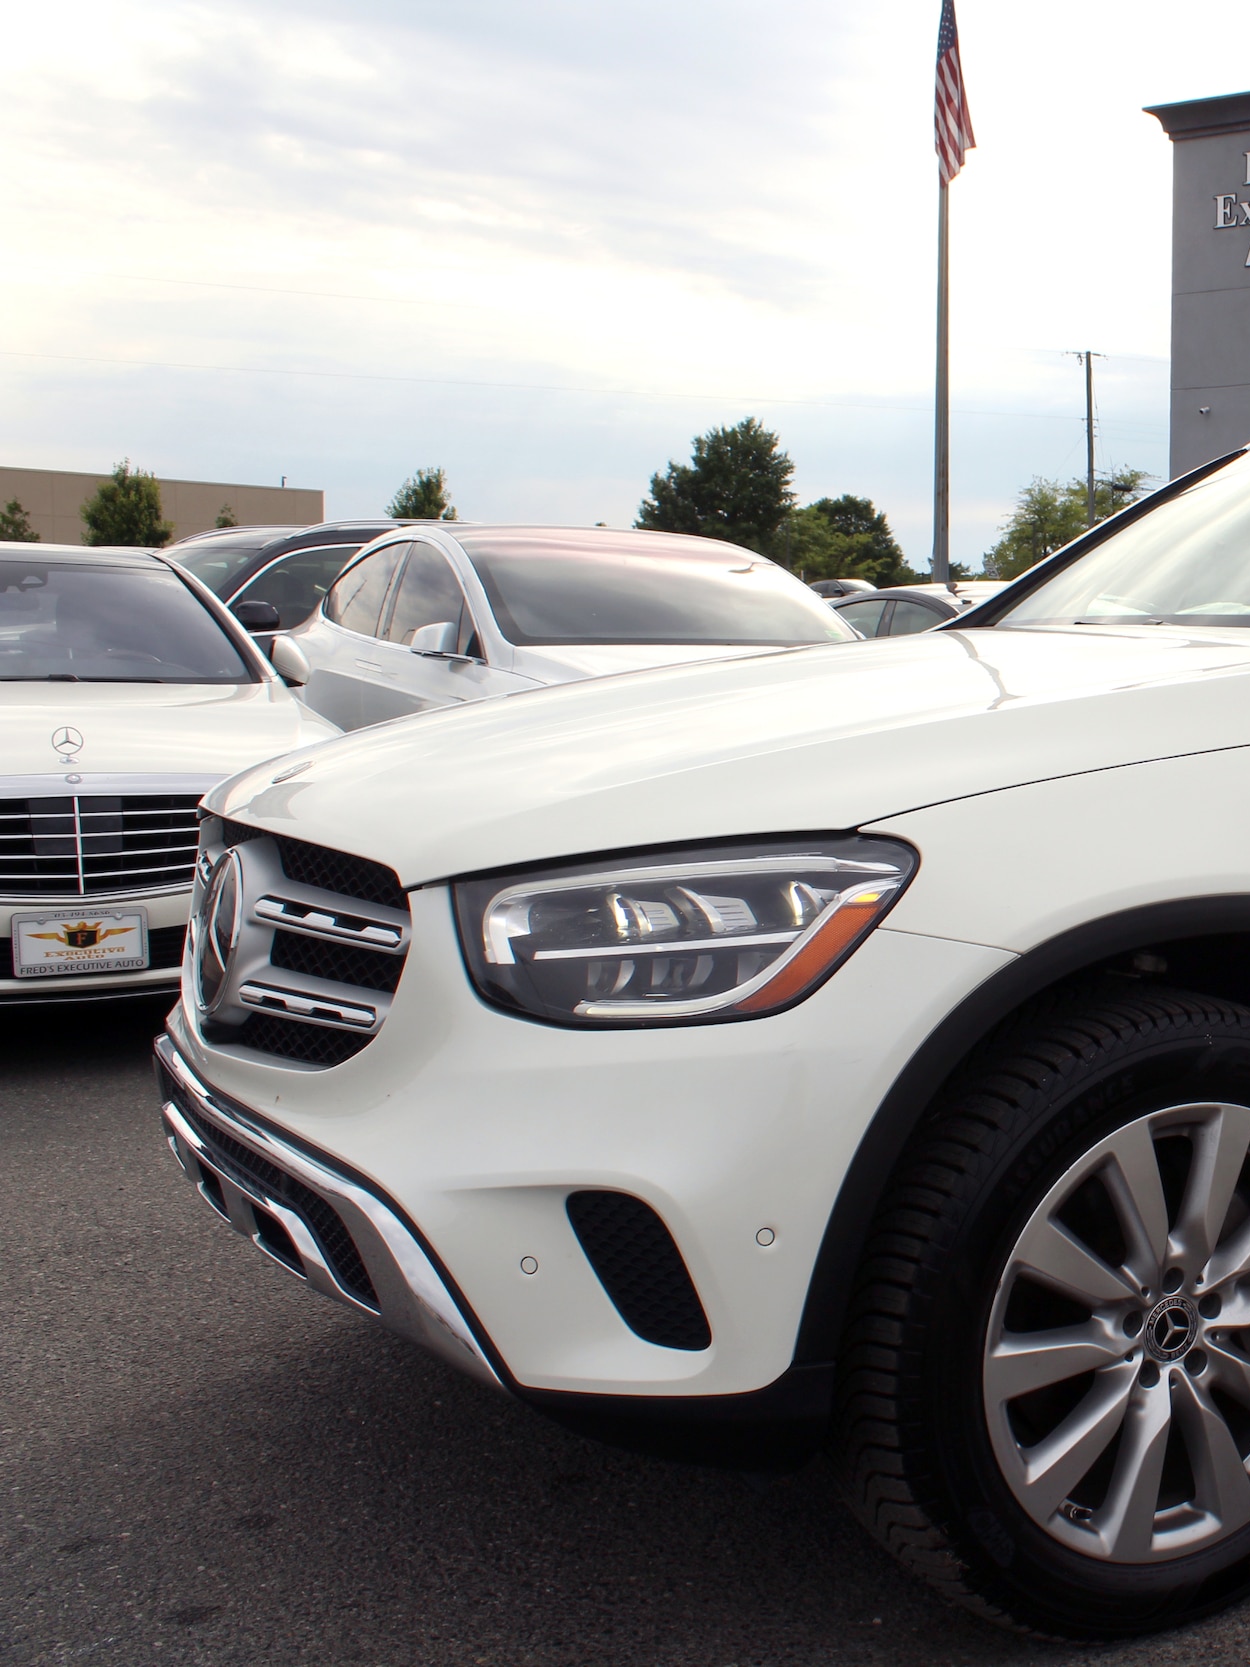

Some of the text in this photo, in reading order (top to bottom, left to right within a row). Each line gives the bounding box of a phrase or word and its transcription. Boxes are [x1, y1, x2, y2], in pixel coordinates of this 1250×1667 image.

[76, 932, 88, 945] F
[20, 959, 144, 975] FRED'S EXECUTIVE AUTO
[1149, 1299, 1182, 1326] MERCEDES
